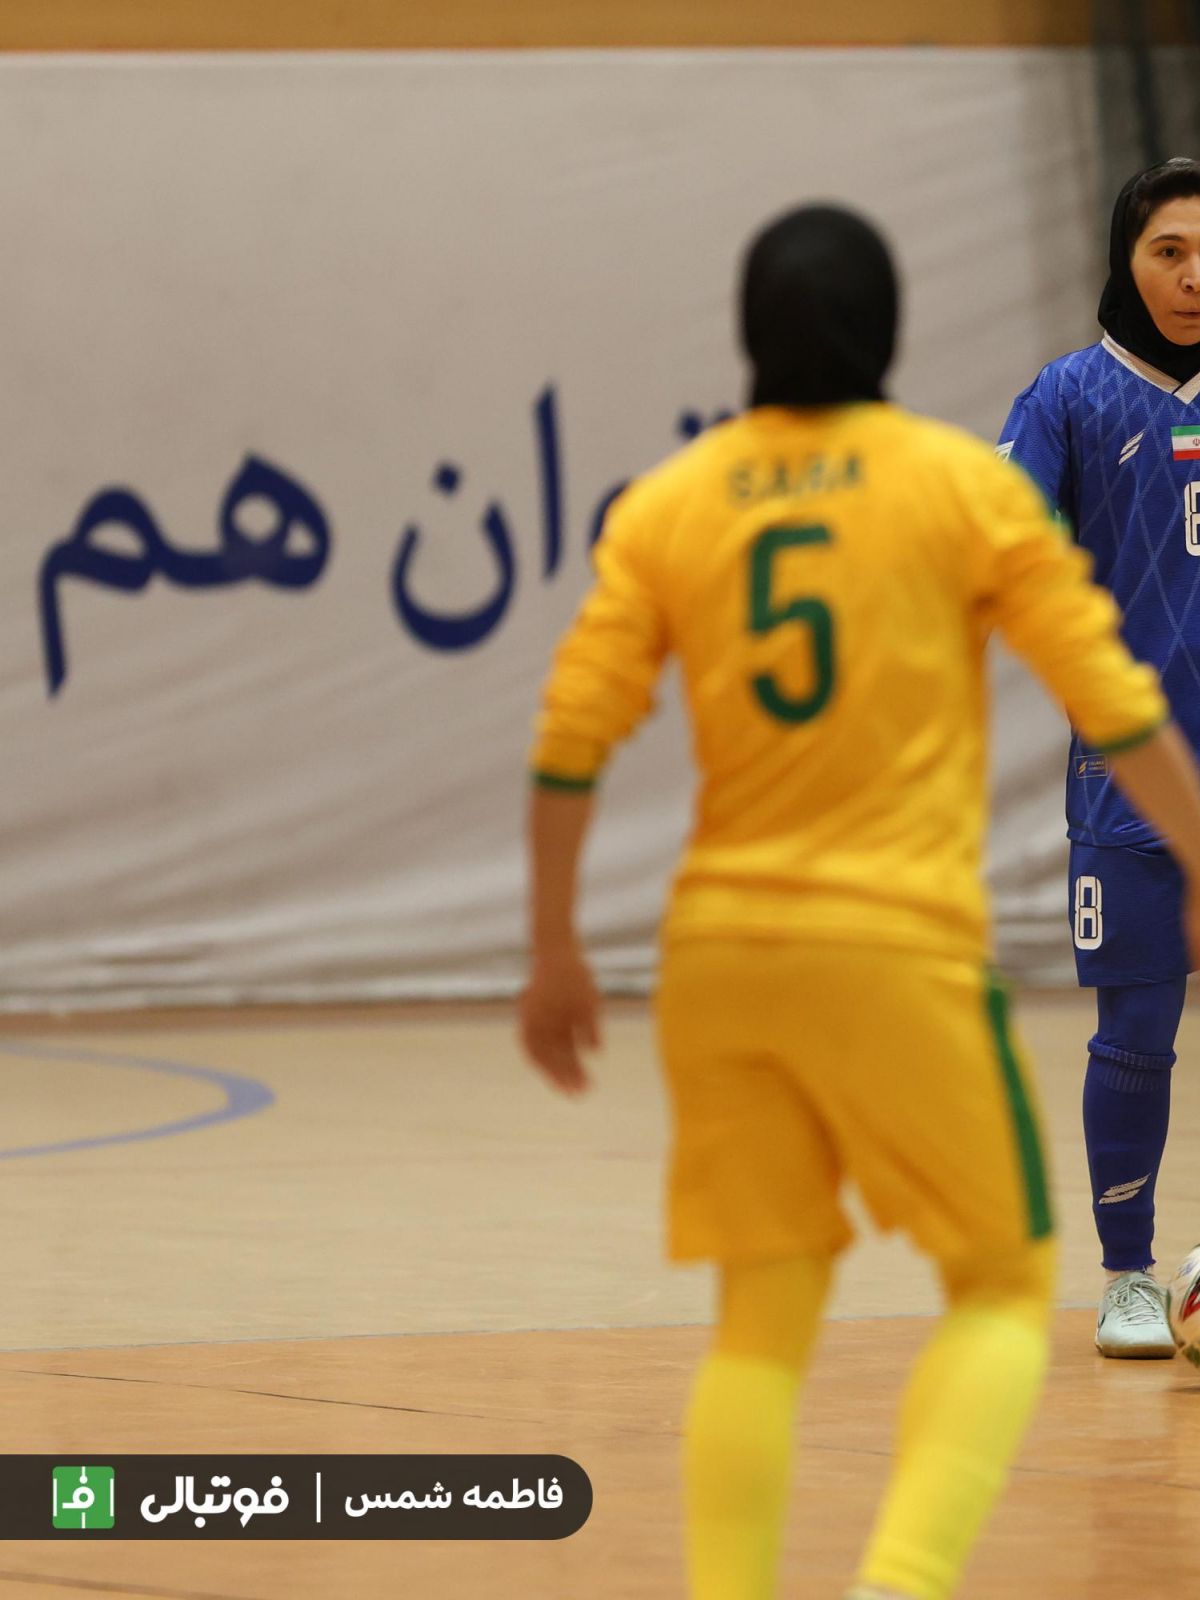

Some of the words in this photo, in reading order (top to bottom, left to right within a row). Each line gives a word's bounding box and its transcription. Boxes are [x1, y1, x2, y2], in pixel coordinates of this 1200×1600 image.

[37, 452, 334, 700] هم
[747, 523, 838, 730] 5
[1074, 875, 1103, 950] 8
